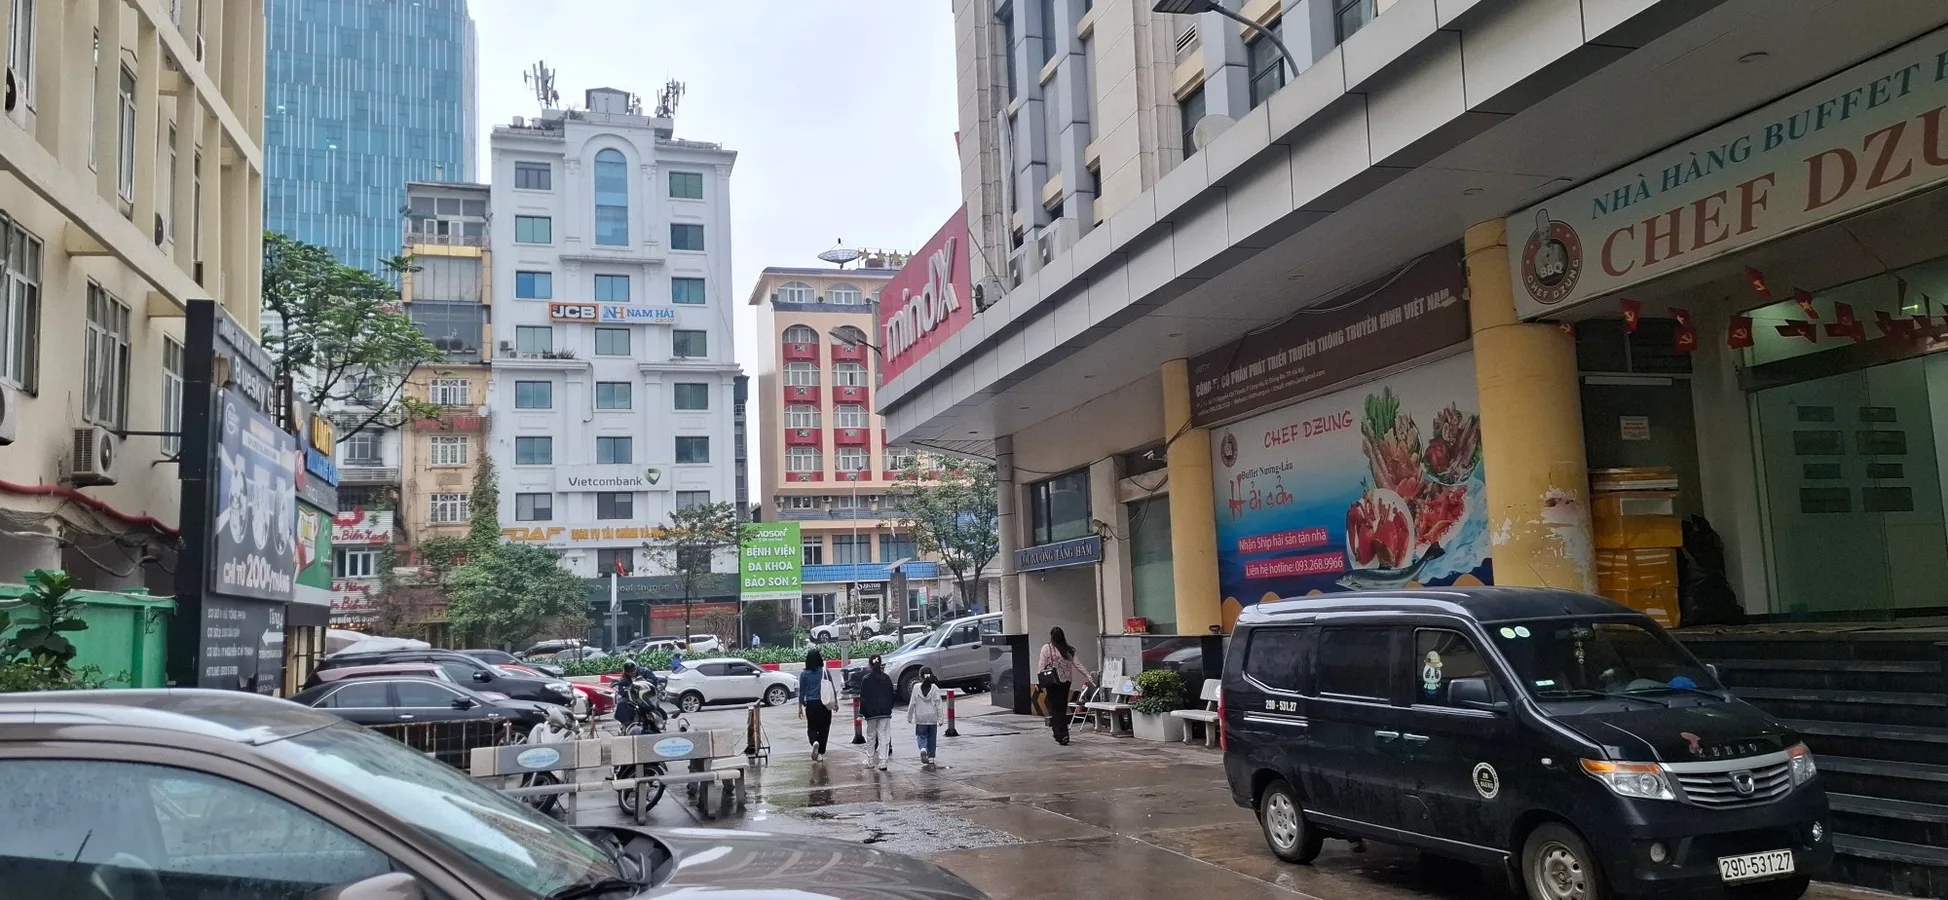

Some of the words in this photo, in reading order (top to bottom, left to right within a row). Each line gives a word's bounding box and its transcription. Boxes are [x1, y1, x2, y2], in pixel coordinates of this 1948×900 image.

[1592, 173, 1652, 220] NHÀ
[1660, 136, 1752, 193] HÀNG
[1762, 63, 1920, 152] BUFFET
[1601, 172, 1776, 277] CHEF
[1528, 276, 1548, 299] CHEF
[1553, 259, 1579, 298] DZUNG
[1540, 262, 1564, 278] BBQ
[886, 236, 961, 363] mindX
[552, 305, 596, 319] JCB
[626, 309, 653, 318] NAM
[1195, 380, 1212, 397] CÔNG
[1249, 359, 1266, 378] PHÁT
[1288, 337, 1316, 363] TRUYỀN
[1317, 329, 1344, 353] THÔNG
[1345, 314, 1378, 341] TRUYỀN
[1403, 297, 1425, 320] VIỆT
[1264, 424, 1298, 448] CHEF
[1303, 410, 1353, 438] DZUNG
[568, 476, 643, 486] Vietcombank
[1241, 468, 1259, 480] Buffet
[1266, 475, 1293, 508] sản
[746, 545, 771, 559] BỆNH
[774, 544, 796, 558] VIỆN
[1239, 540, 1257, 553] Nhận
[1257, 536, 1272, 550] Ship
[1272, 534, 1284, 546] hải
[1285, 532, 1297, 544] sản
[1298, 531, 1310, 546] tận
[1312, 528, 1326, 541] nhà
[748, 562, 762, 572] ĐA
[765, 561, 794, 571] KHOA
[1246, 564, 1259, 576] Liên
[1260, 563, 1269, 577] hệ
[1269, 562, 1295, 574] hotline:
[1295, 556, 1343, 572] 093.268.9966
[744, 574, 766, 587] BẢO
[768, 575, 789, 586] SƠN
[792, 576, 798, 586] 2
[1722, 852, 1791, 880] 29D-531.27
